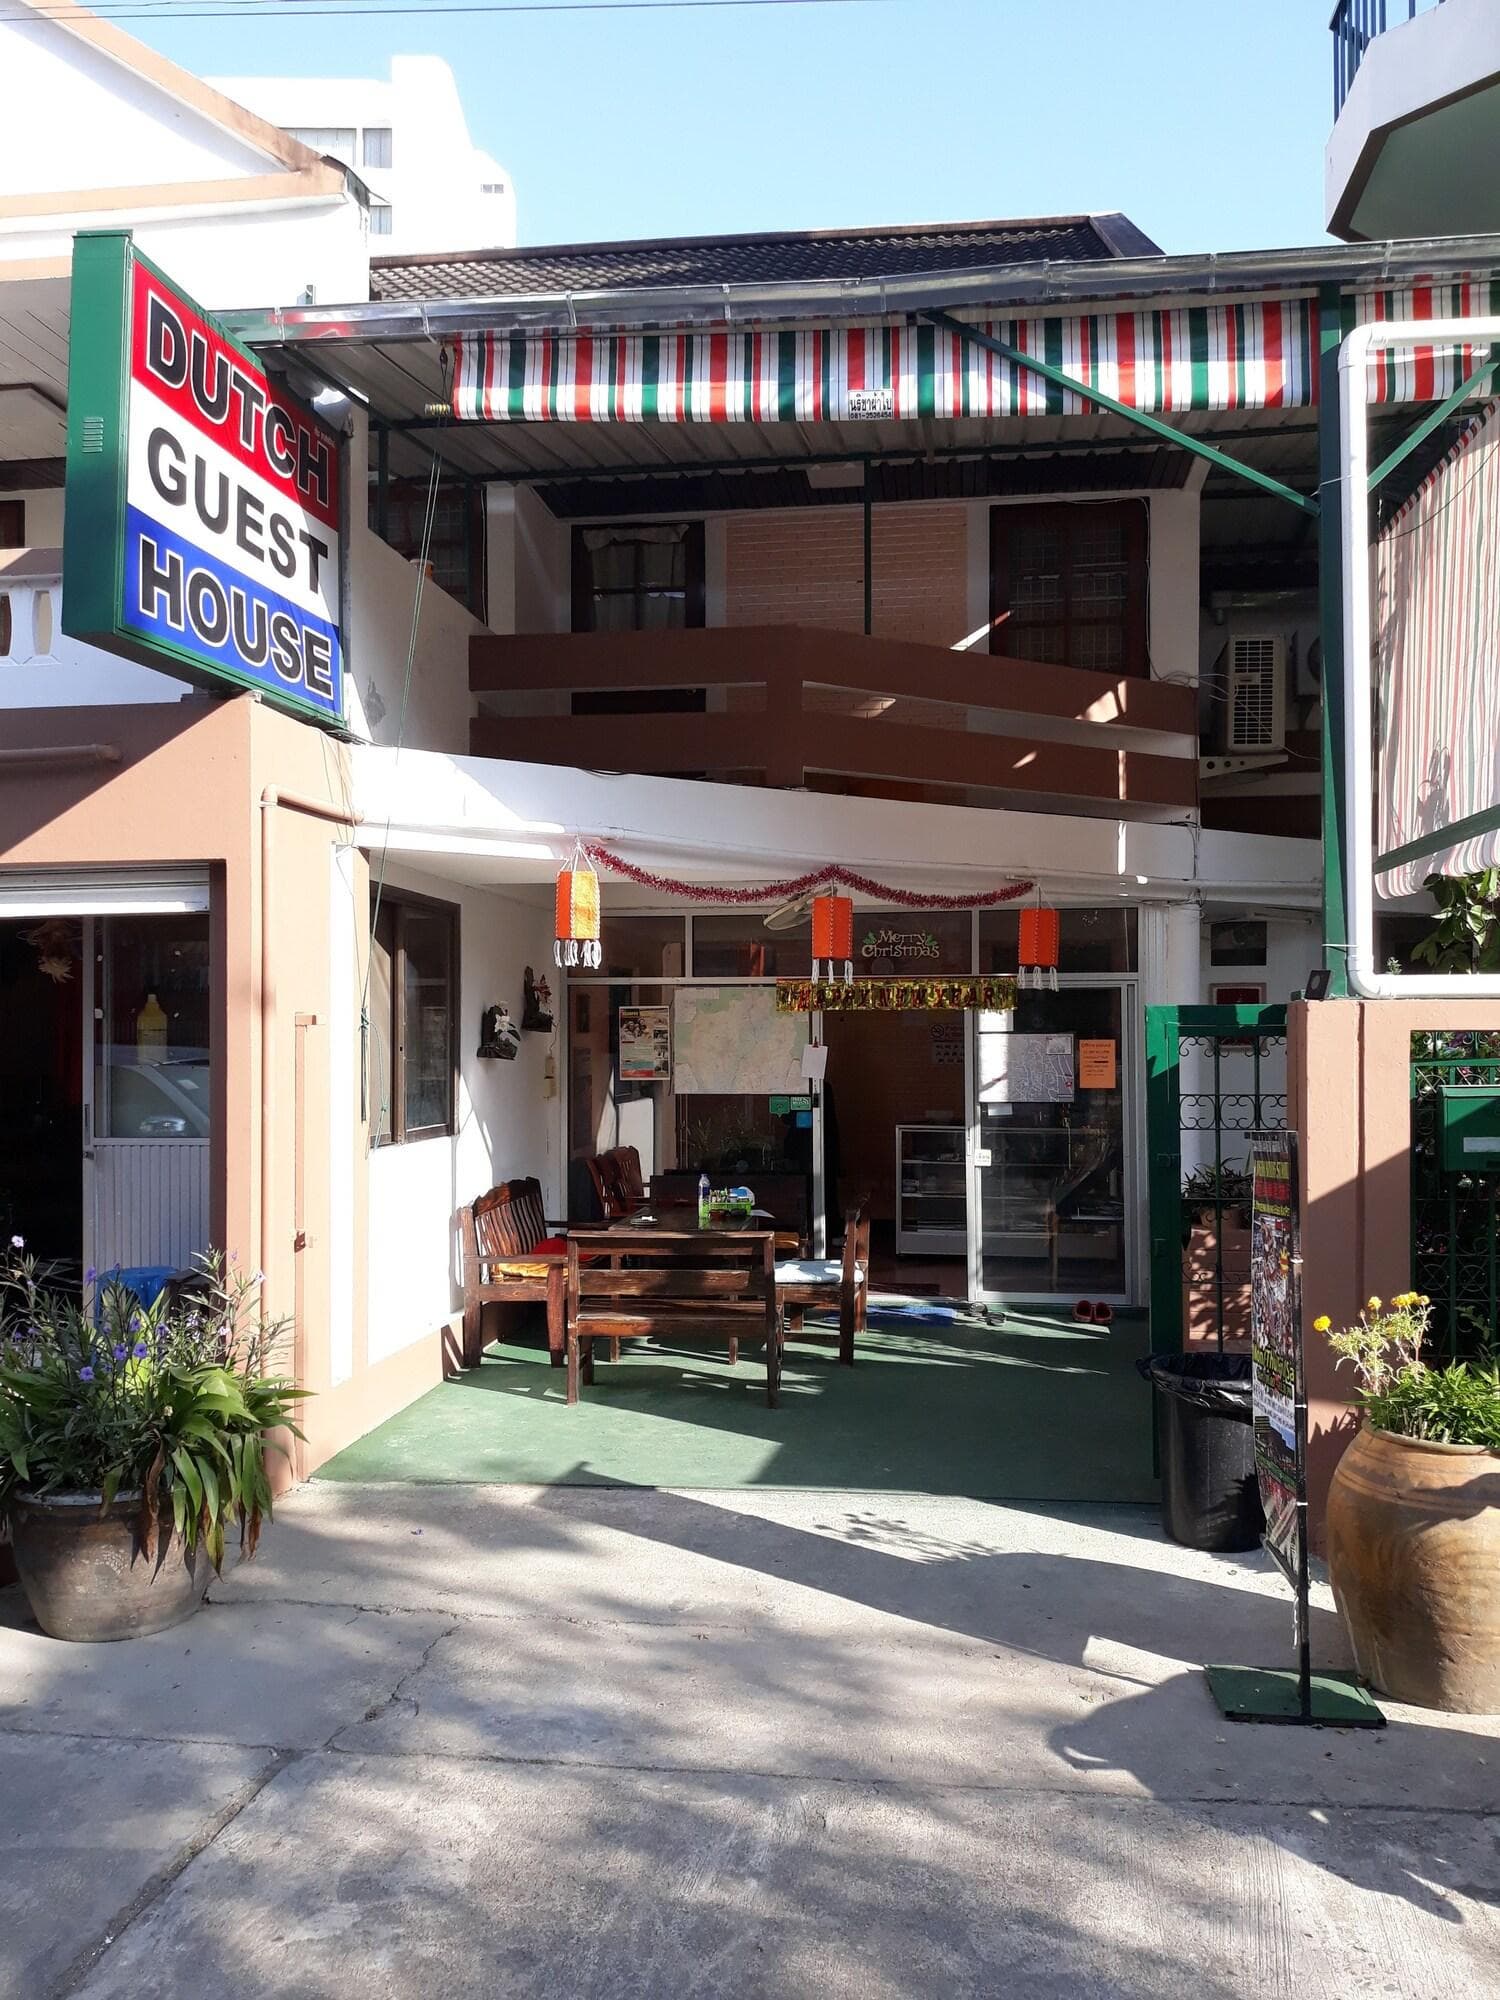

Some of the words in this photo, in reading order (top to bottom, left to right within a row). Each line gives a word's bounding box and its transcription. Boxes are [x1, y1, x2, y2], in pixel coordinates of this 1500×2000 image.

[147, 289, 329, 509] DUTCH
[147, 427, 329, 595] GUEST
[139, 533, 334, 700] HOUSE
[862, 944, 940, 960] Christmas
[877, 929, 927, 946] Merry
[798, 986, 871, 1009] HAPPY
[878, 986, 928, 1009] NEW
[932, 985, 995, 1008] YEAR
